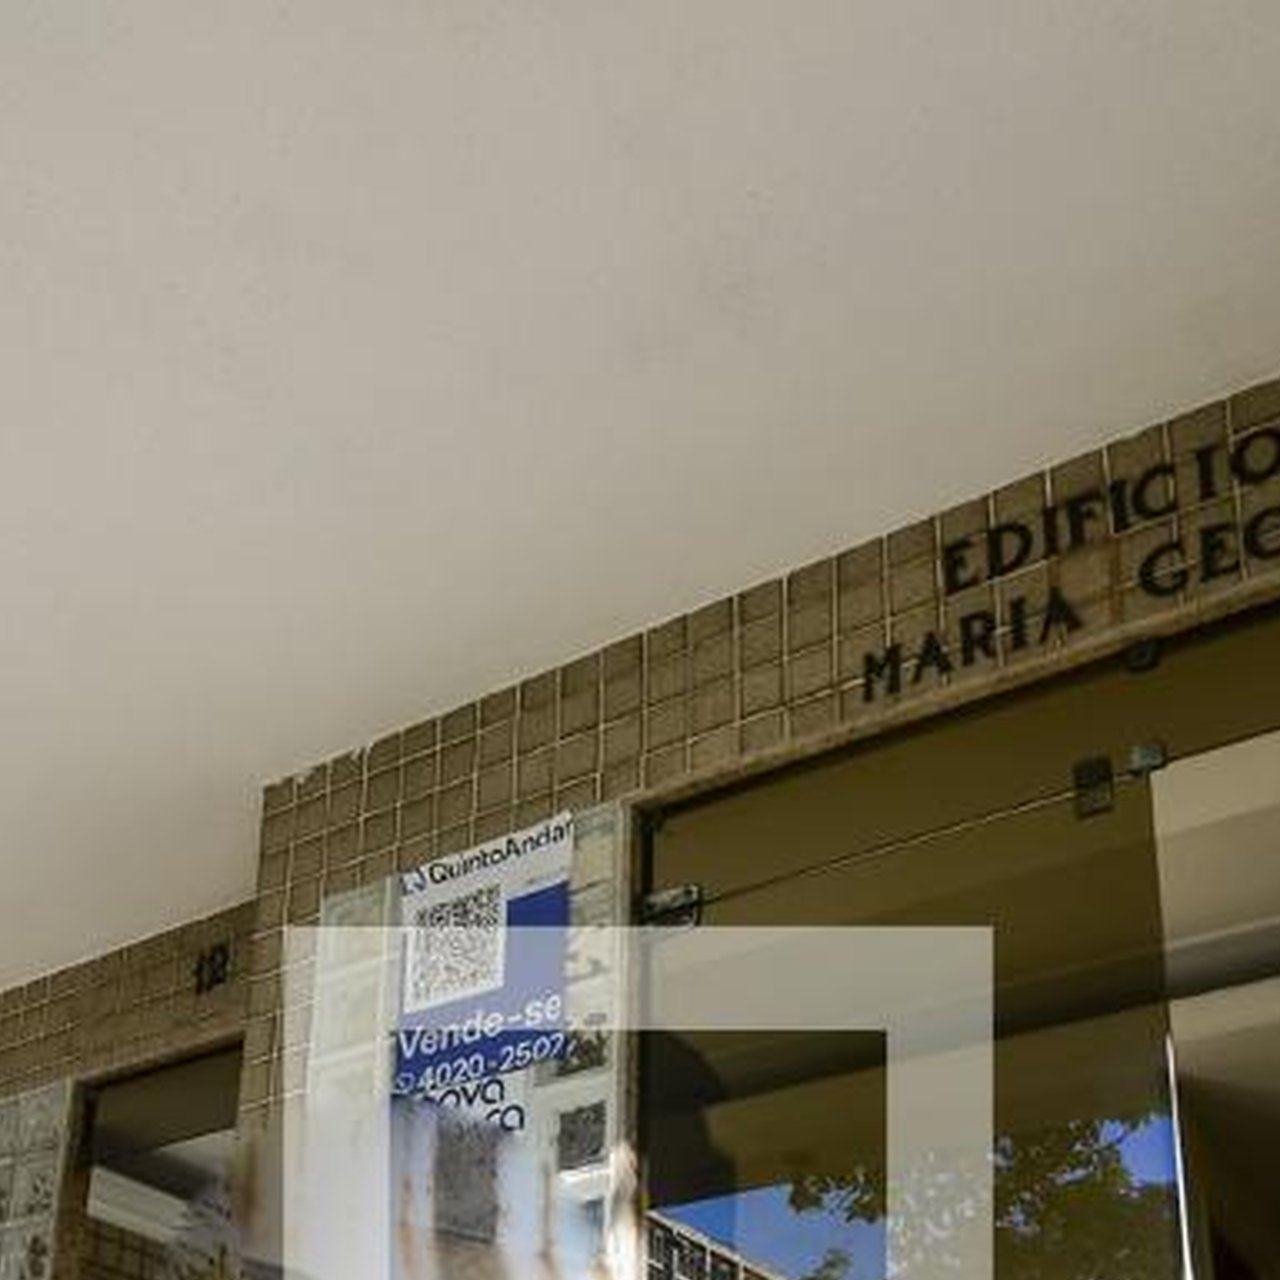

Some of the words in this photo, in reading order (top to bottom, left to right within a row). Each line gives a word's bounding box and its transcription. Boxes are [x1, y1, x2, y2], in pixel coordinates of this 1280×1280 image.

[861, 586, 1084, 703] MARIA
[428, 820, 572, 886] QuintoAndar
[398, 993, 563, 1060] Vende-se
